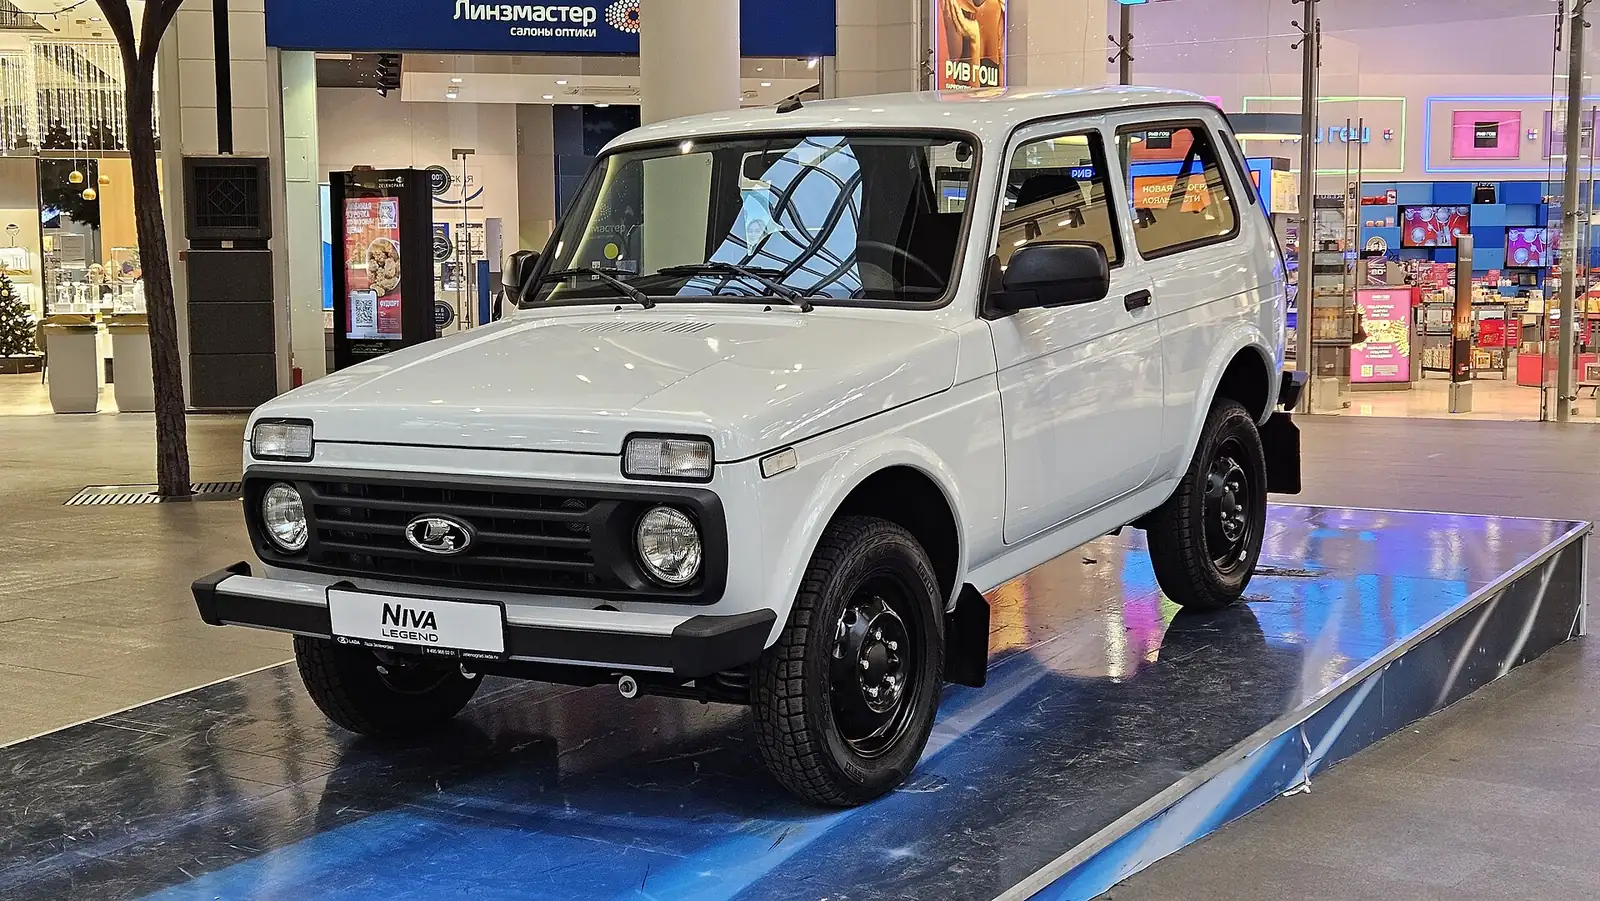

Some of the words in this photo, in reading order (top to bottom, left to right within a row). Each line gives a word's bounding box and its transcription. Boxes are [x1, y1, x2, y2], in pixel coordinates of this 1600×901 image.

[453, 0, 597, 27] Линзмастер
[510, 26, 553, 37] салоны
[555, 27, 597, 38] оптики
[945, 60, 971, 82] РИВ
[972, 64, 998, 87] ГОШ
[1142, 185, 1173, 193] НОВАЯ
[381, 602, 438, 630] NIVA
[382, 628, 439, 642] LEGEND
